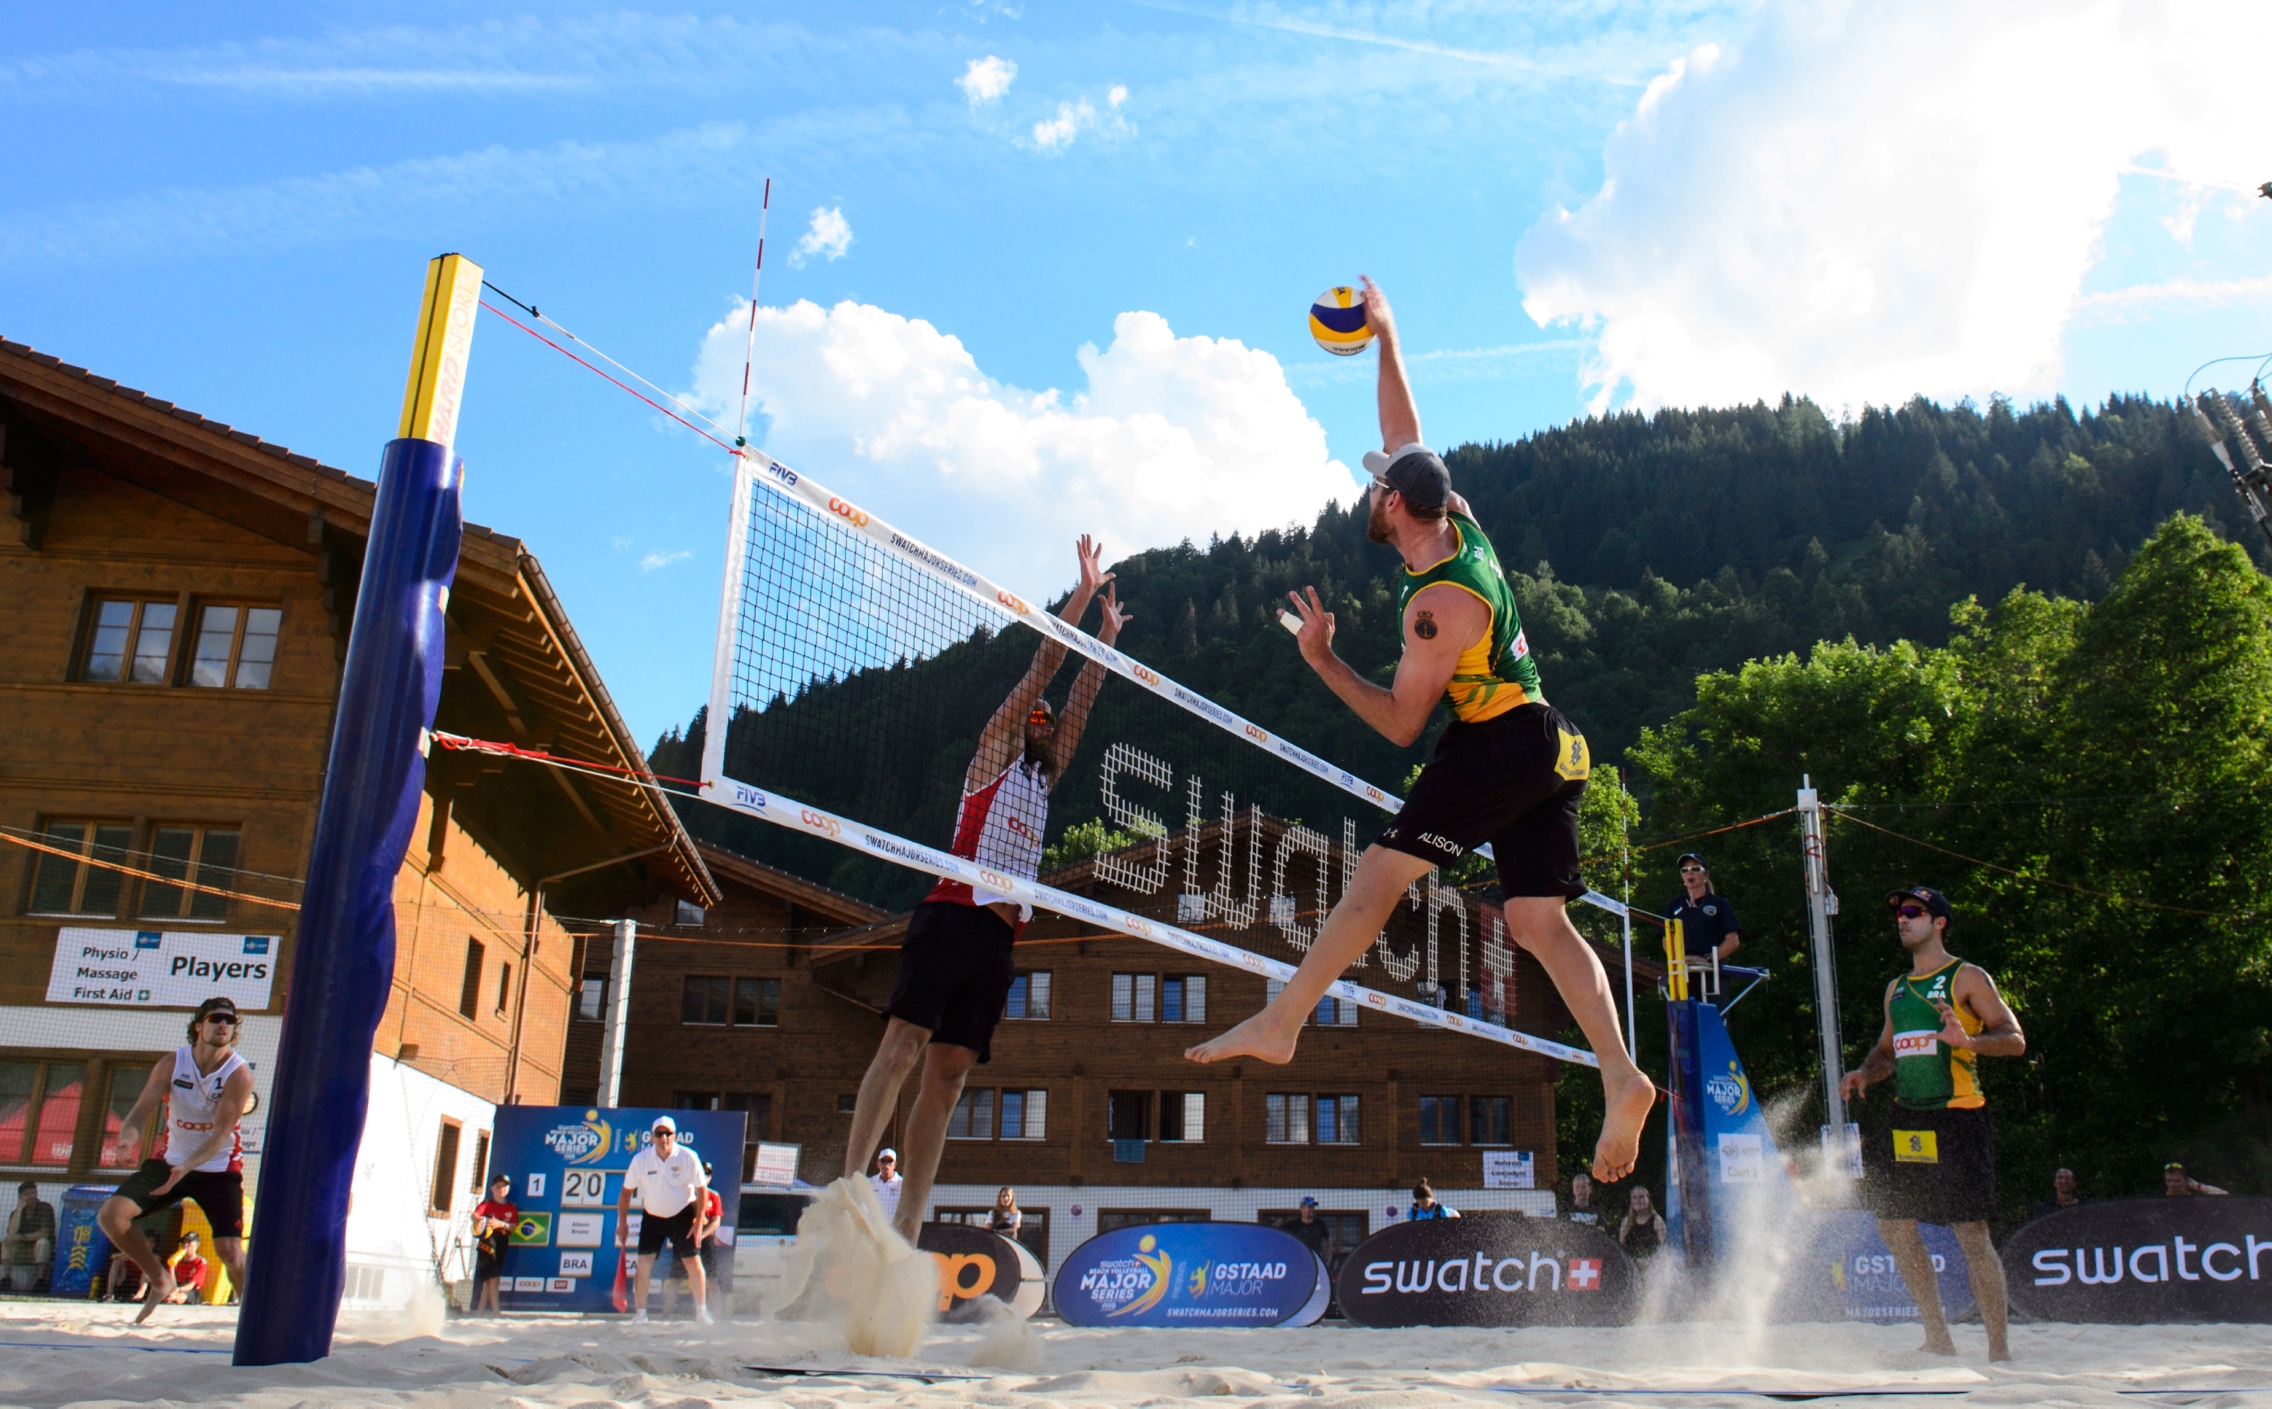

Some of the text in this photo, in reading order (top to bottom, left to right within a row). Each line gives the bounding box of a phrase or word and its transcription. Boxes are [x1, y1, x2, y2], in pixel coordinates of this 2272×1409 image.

[433, 286, 473, 446] HARD SPORT
[768, 461, 799, 486] FIVB
[828, 496, 870, 528] coop
[890, 532, 978, 588] SWATCHMAJORSERIES.COM
[997, 589, 1030, 616] coop
[1133, 662, 1160, 687] coop
[1174, 687, 1233, 725] SWATCHMAJORSERIES.COM
[1245, 723, 1268, 743] coop
[1341, 772, 1354, 786] FIVB
[736, 785, 767, 808] FIVB
[1366, 785, 1385, 803] coop
[801, 809, 841, 837] coop
[1008, 816, 1040, 848] coop
[1416, 832, 1464, 857] ALISON
[865, 833, 960, 875] SWATCHMAJORSERIES.COM
[980, 869, 1014, 893] coop
[1124, 915, 1152, 936] coop
[82, 946, 129, 961] Physio
[170, 955, 267, 982] Players
[1242, 953, 1266, 972] coop
[76, 967, 138, 983] Massage
[1933, 975, 1946, 990] 2
[74, 987, 133, 1000] First Aid
[1368, 992, 1387, 1008] coop
[1927, 990, 1946, 999] BRA
[1446, 1014, 1463, 1029] coop
[1894, 1033, 1929, 1052] coop
[215, 1077, 223, 1090] 1
[1706, 1083, 1741, 1097] MAJOR
[211, 1092, 221, 1100] CA
[1714, 1095, 1736, 1105] SERIES
[176, 1118, 215, 1133] coop
[545, 1133, 598, 1146] MAJOR
[641, 1131, 694, 1144] GAD
[554, 1144, 587, 1153] SERIES
[532, 1177, 541, 1192] 1
[565, 1172, 602, 1198] 20
[563, 1259, 587, 1269] BRA
[626, 1260, 637, 1270] CA
[1100, 1259, 1135, 1268] swatch
[1855, 1254, 1946, 1275] GSTD
[2032, 1233, 2272, 1287] swatch
[1110, 1267, 1149, 1275] VOLLEYBALL
[1215, 1262, 1287, 1280] GSTAAD
[1361, 1250, 1561, 1295] swatch
[519, 1280, 540, 1288] coop
[1080, 1273, 1152, 1290] MAJOR
[1210, 1279, 1264, 1296] MAJOR
[1854, 1274, 1907, 1292] MAJO
[1091, 1288, 1135, 1300] SERIES
[1166, 1307, 1278, 1319] SWATCHMAJORSERIES.COM
